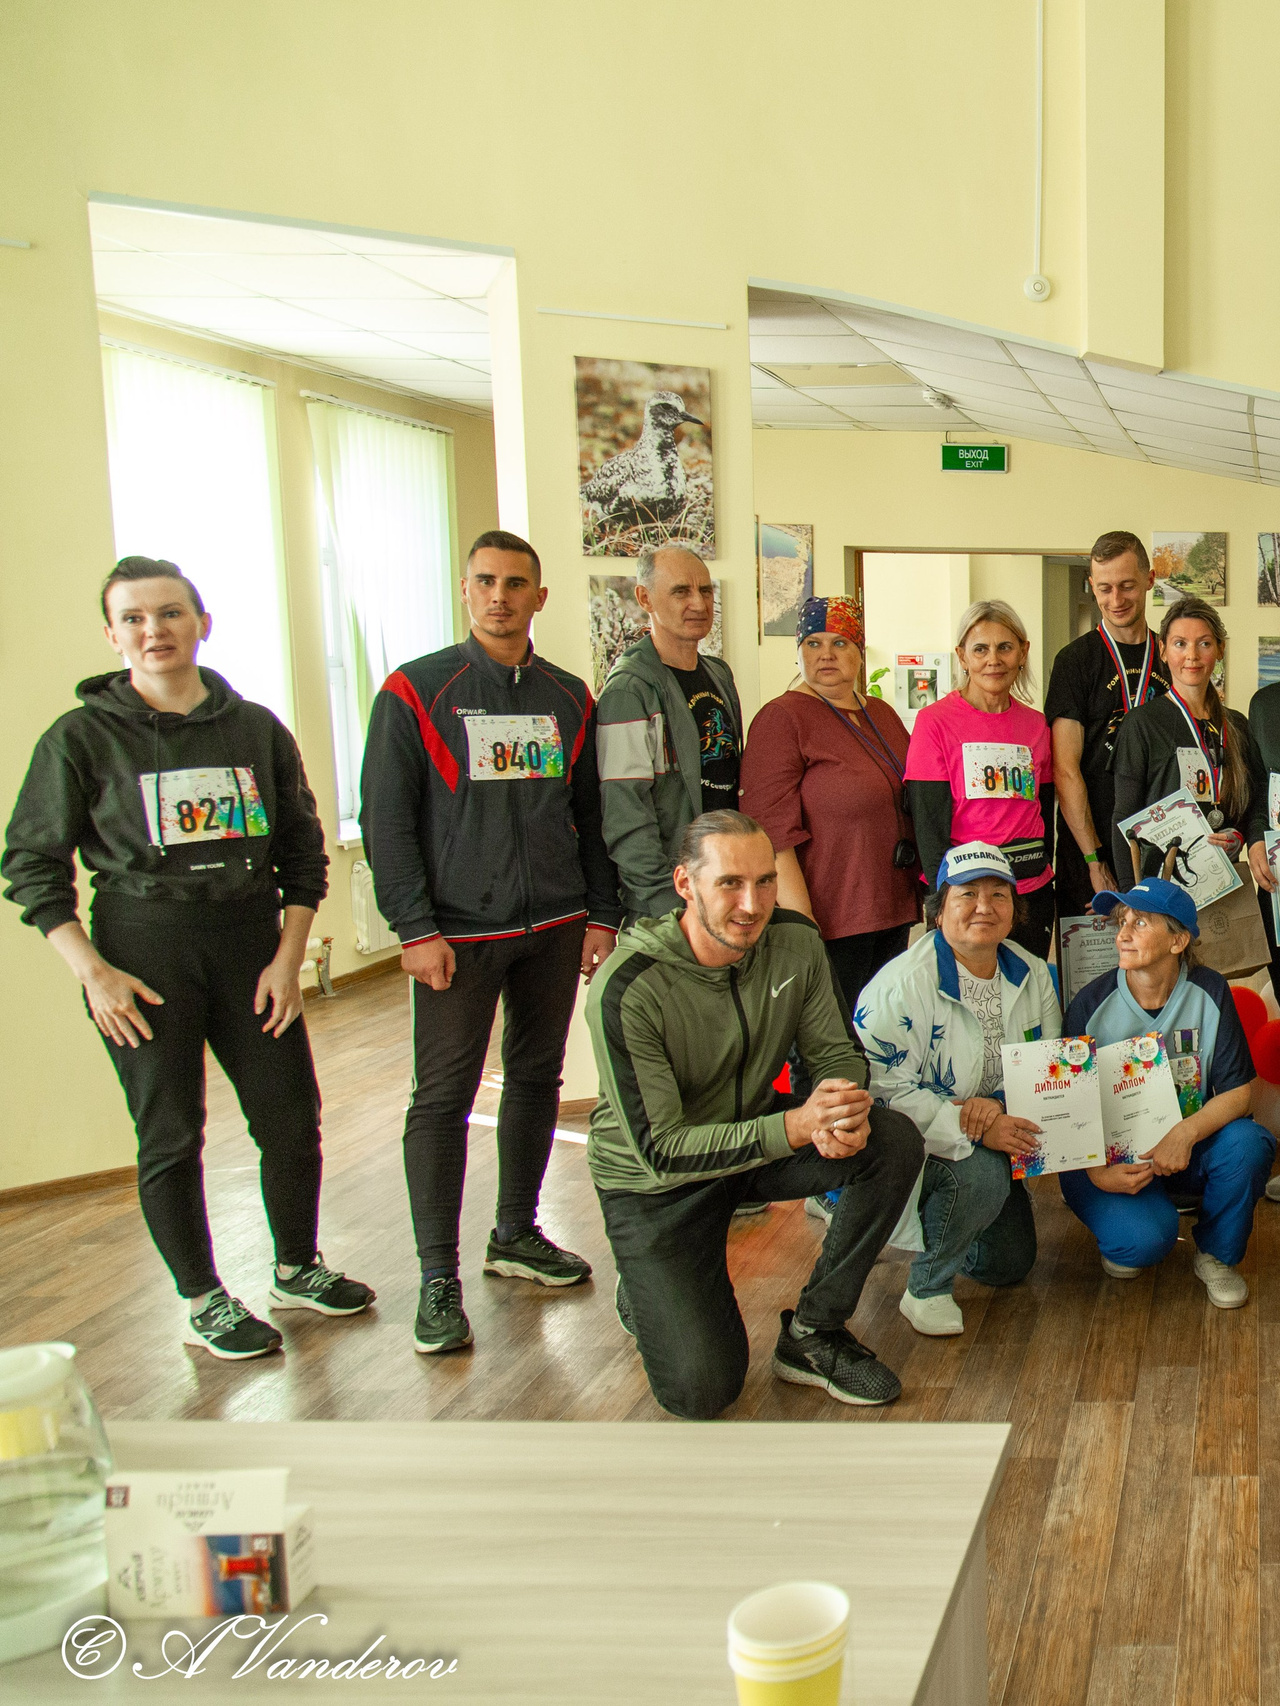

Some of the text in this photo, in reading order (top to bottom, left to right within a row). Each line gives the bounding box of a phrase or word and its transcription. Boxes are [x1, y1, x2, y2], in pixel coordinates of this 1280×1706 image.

[958, 449, 989, 460] ВЫХОД
[965, 460, 984, 468] EXIT
[452, 706, 487, 715] FORWARD
[492, 741, 542, 772] 840
[984, 765, 1023, 792] 810
[176, 796, 236, 833] 827
[1014, 852, 1044, 863] DEMIX
[1034, 1079, 1071, 1094] ДИПЛОМ
[1113, 1075, 1146, 1095] ДИПЛОМ
